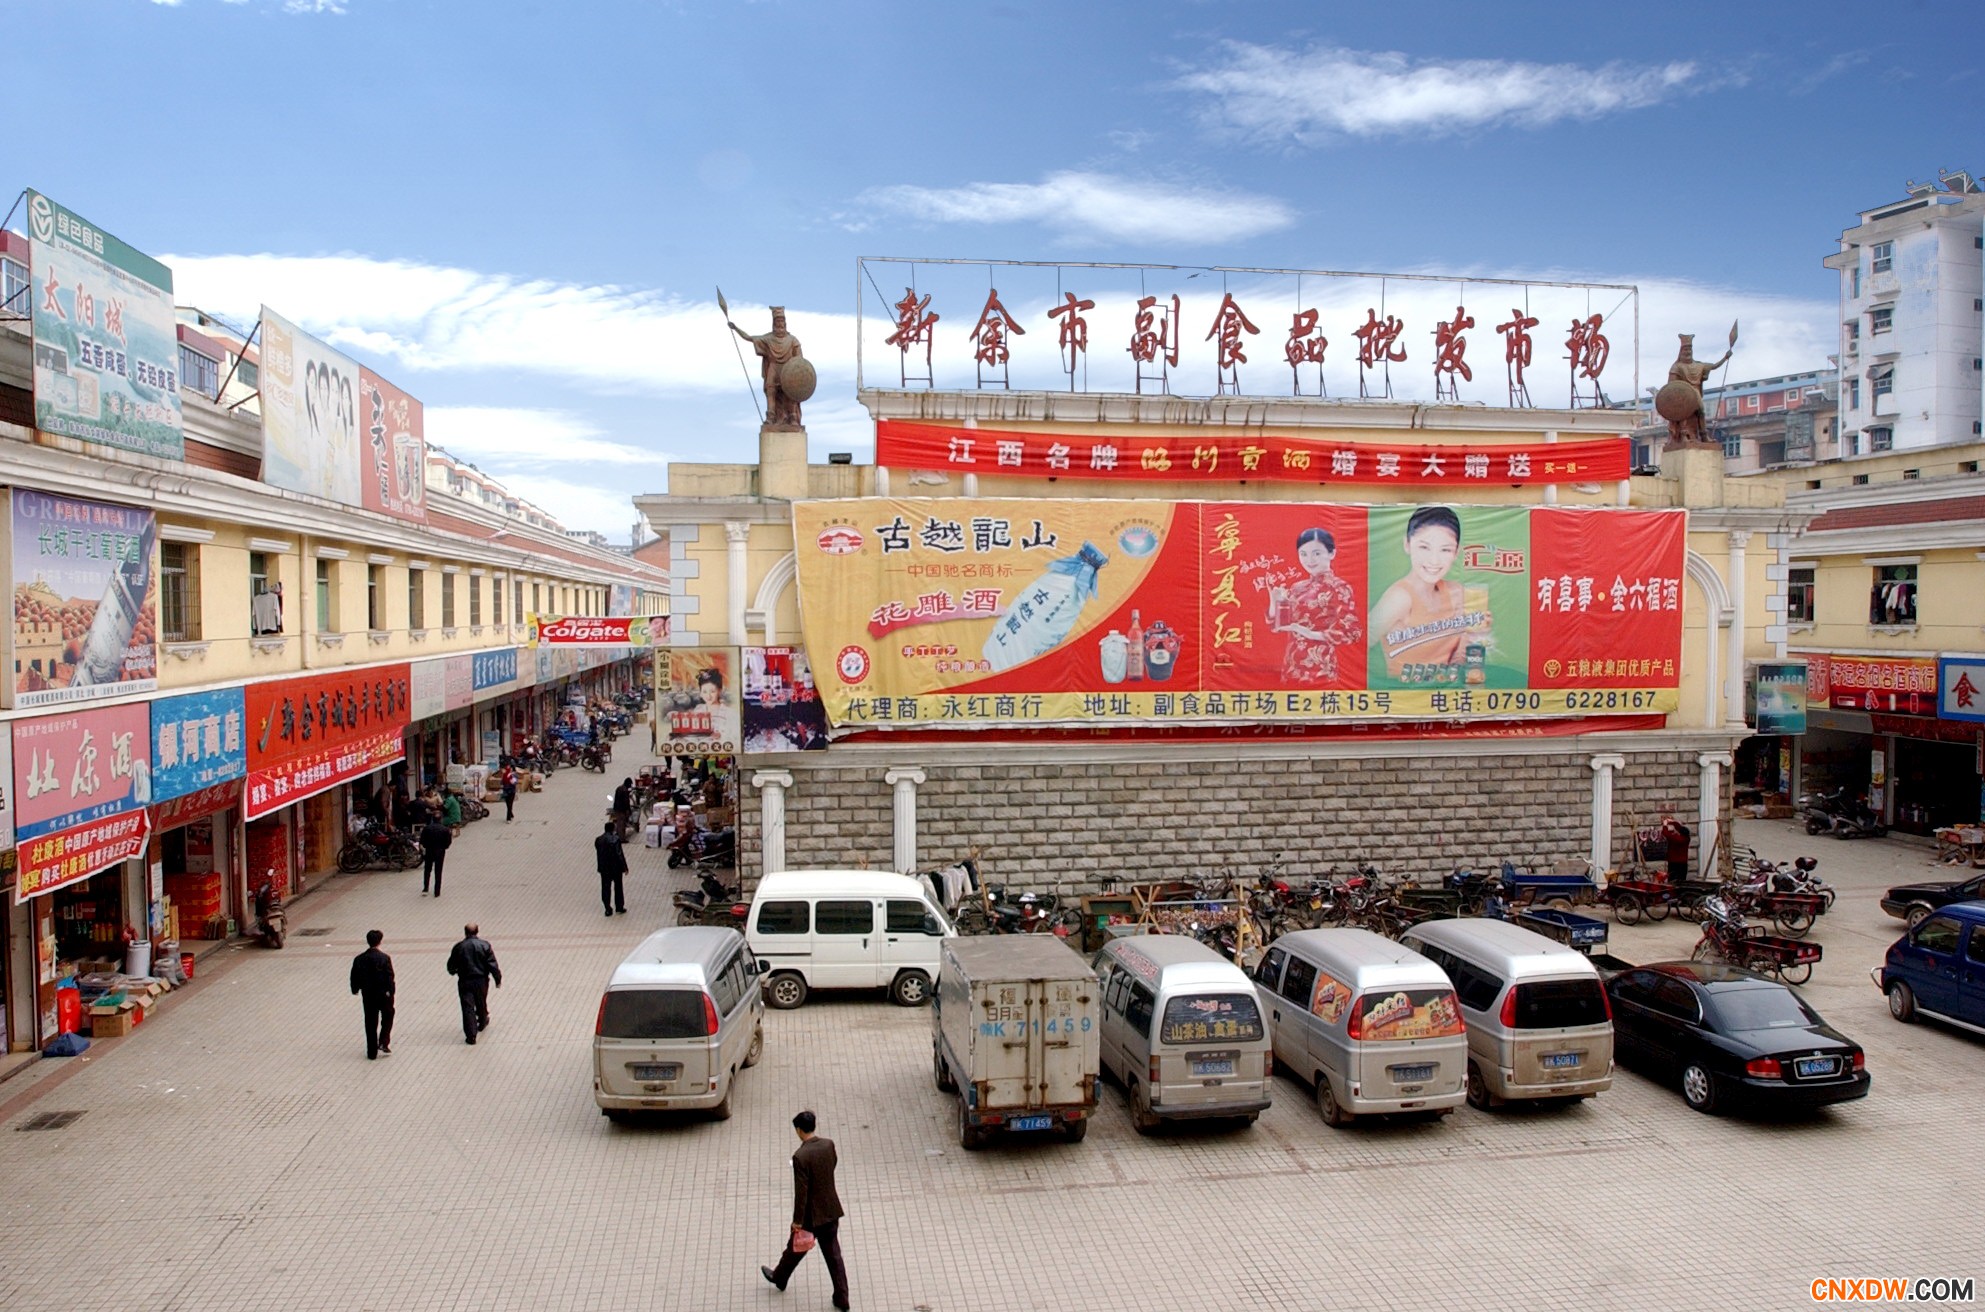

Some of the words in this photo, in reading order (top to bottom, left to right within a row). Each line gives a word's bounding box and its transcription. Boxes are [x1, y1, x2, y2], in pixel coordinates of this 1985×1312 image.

[57, 212, 104, 254] 绿色食品
[43, 265, 126, 346] 太阳城
[38, 522, 140, 564] 长城干红葡萄酒
[1464, 550, 1525, 569] 汇源
[907, 563, 1015, 579] 中国驰名商标
[872, 588, 1003, 626] 花雕酒
[543, 624, 626, 640] Colgate
[1566, 658, 1674, 678] 五粮液集团优质产品
[941, 696, 1043, 720] 永红商行
[1487, 692, 1541, 712] 0790
[1566, 690, 1656, 709] 6228167
[1952, 671, 1980, 708] 食
[158, 708, 241, 770] 银河商店
[26, 728, 135, 800] 杜康酒
